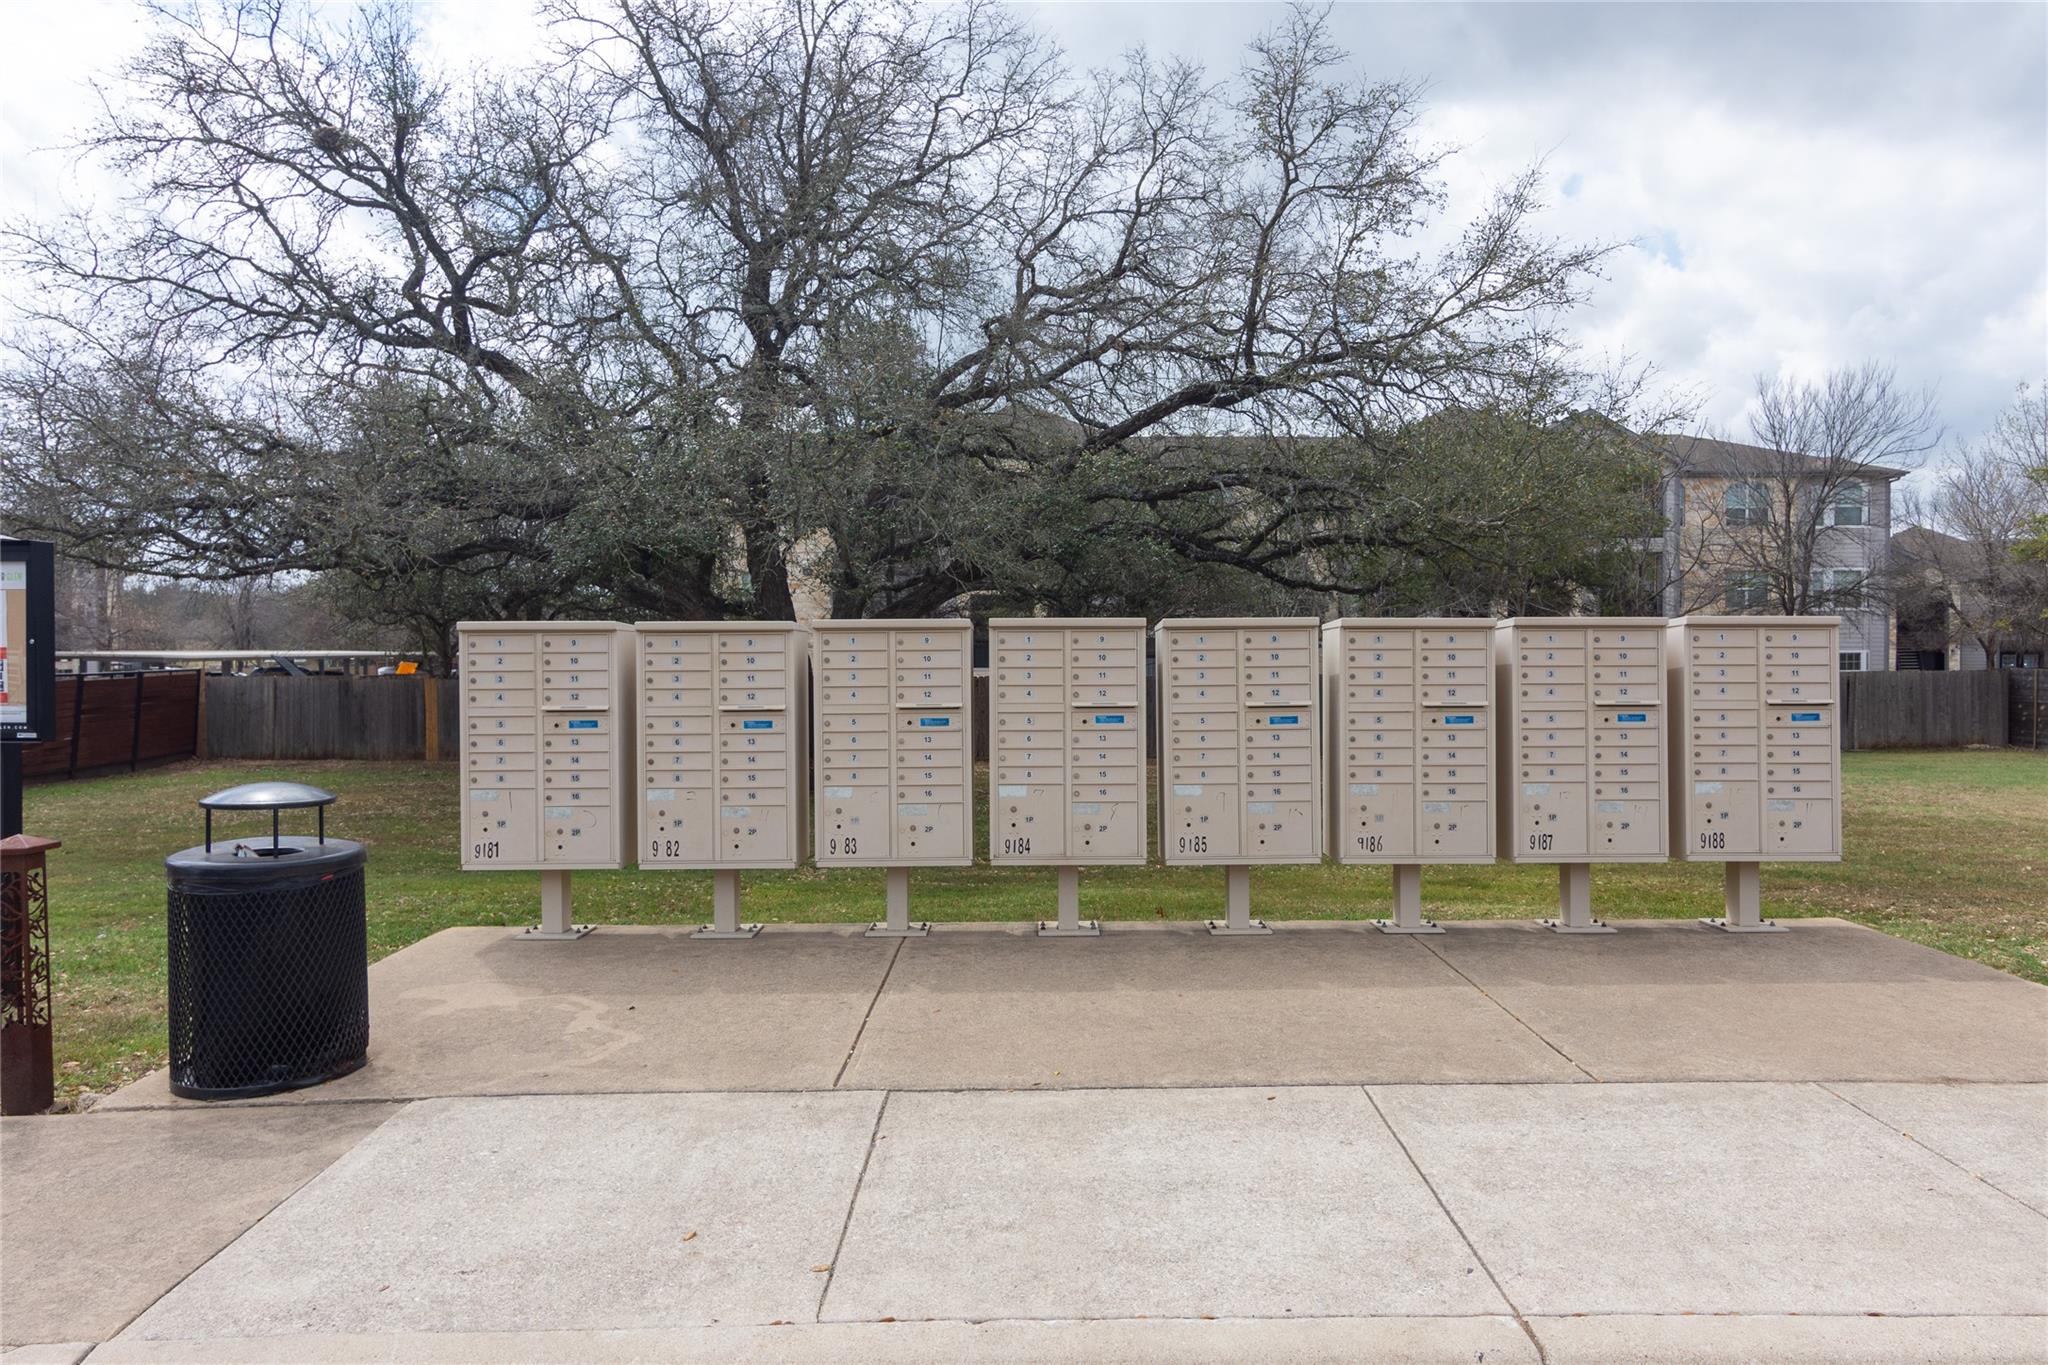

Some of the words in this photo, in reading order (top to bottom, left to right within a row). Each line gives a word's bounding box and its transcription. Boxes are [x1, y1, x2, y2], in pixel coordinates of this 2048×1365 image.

[497, 639, 502, 647] 1
[571, 639, 577, 647] 9
[674, 639, 679, 647] 1
[1271, 635, 1277, 643] 9
[1448, 635, 1455, 643] 9
[850, 655, 857, 663] 2
[1198, 654, 1205, 662] 2
[1271, 653, 1280, 661] 10
[1375, 653, 1382, 661] 2
[1447, 653, 1456, 661] 10
[1547, 652, 1554, 660] 2
[1619, 652, 1628, 660] 10
[1719, 651, 1725, 659] 2
[1791, 651, 1800, 659] 10
[497, 657, 504, 665] 2
[570, 657, 579, 665] 10
[673, 657, 680, 665] 2
[851, 673, 857, 681] 3
[1098, 671, 1106, 679] 11
[1376, 671, 1382, 679] 3
[1548, 670, 1554, 678] 3
[1719, 669, 1726, 677] 3
[497, 675, 504, 683] 3
[674, 675, 680, 683] 3
[747, 692, 756, 700] 12
[1271, 689, 1280, 697] 12
[1619, 688, 1628, 696] 12
[570, 693, 579, 701] 12
[674, 693, 680, 701] 4
[851, 718, 857, 726] 5
[1376, 716, 1382, 724] 5
[498, 721, 504, 729] 5
[571, 738, 579, 746] 13
[571, 756, 580, 764] 14
[1272, 769, 1281, 777] 15
[1620, 768, 1629, 776] 15
[1792, 767, 1801, 775] 15
[571, 774, 580, 782] 15
[747, 774, 756, 782] 15
[1179, 836, 1207, 853] 9185
[1358, 835, 1383, 852] 9186
[1529, 833, 1553, 851] 9187
[1700, 832, 1725, 849] 9188
[474, 841, 500, 859] 9181
[1004, 838, 1030, 854] 9184
